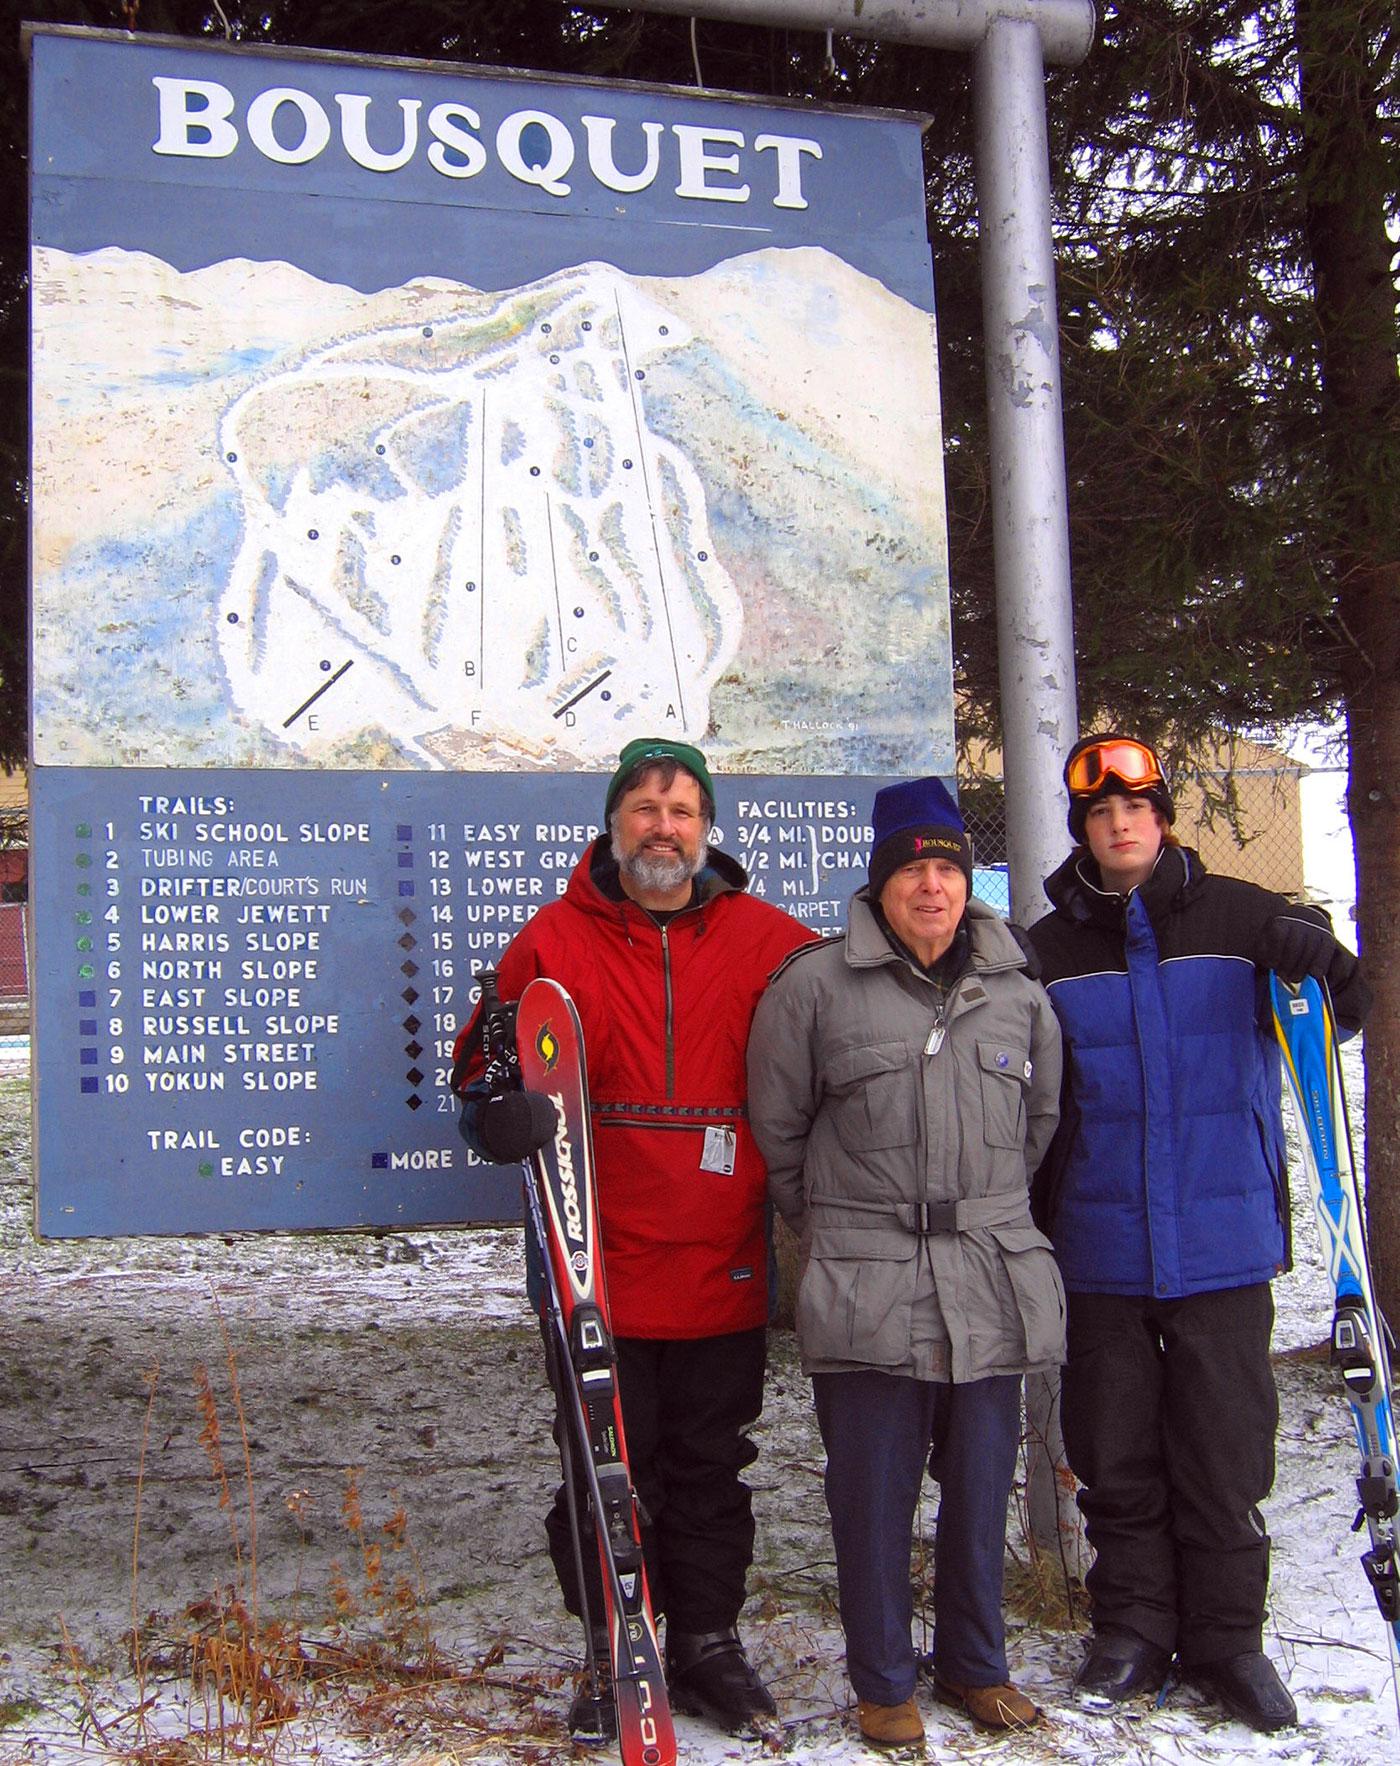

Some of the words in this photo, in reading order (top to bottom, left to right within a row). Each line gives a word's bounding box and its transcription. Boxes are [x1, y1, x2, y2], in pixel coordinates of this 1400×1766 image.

[152, 76, 823, 209] BOUSQUET
[567, 637, 577, 652] C
[464, 661, 476, 676] B
[471, 710, 482, 726] F
[565, 711, 576, 727] D
[665, 703, 676, 719] A
[308, 714, 320, 731] E
[138, 796, 234, 816] TRAILS:
[738, 800, 856, 819] FACILITIES:
[106, 822, 114, 840] 1
[140, 822, 178, 841] SKI
[195, 823, 289, 842] SCHOOL
[299, 823, 370, 842] SLOPE
[427, 823, 446, 841] 11
[464, 824, 521, 842] EASY
[535, 824, 600, 843] RIDER
[737, 823, 772, 849] 3/4
[779, 826, 806, 843] MI.
[821, 825, 875, 844] DOUB
[106, 850, 119, 869] 2
[141, 848, 213, 867] TUBING
[227, 849, 279, 867] AREA
[429, 850, 450, 869] 12
[464, 850, 525, 869] WEST
[739, 850, 769, 873] 1/2
[779, 851, 807, 869] MI.
[107, 878, 120, 897] 3
[331, 878, 367, 896] RUN
[430, 878, 452, 896] 13
[467, 877, 543, 896] LOWER
[744, 873, 767, 897] /4
[782, 879, 810, 896] MI.
[104, 905, 120, 924] 4
[141, 904, 219, 924] LOWER
[237, 905, 331, 924] JEWETT
[431, 905, 454, 923] 14
[467, 904, 539, 923] UPPER
[108, 932, 121, 952] 5
[142, 933, 230, 953] HARRIS
[246, 932, 320, 952] SLOPE
[432, 932, 453, 950] 15
[468, 931, 519, 949] UPP
[107, 961, 121, 979] 6
[143, 960, 222, 980] NORTH
[241, 960, 317, 980] SLOPE
[432, 959, 454, 978] 16
[109, 988, 122, 1008] 7
[143, 988, 206, 1008] EAST
[224, 988, 300, 1007] SLOPE
[432, 986, 454, 1004] 17
[109, 1017, 123, 1036] 8
[143, 1016, 250, 1036] RUSSELL
[265, 1015, 339, 1036] SLOPE
[433, 1013, 456, 1032] 18
[110, 1045, 125, 1064] 9
[143, 1044, 205, 1065] MAIN
[224, 1043, 315, 1063] STREET
[434, 1040, 455, 1058] 19
[105, 1073, 129, 1093] 10
[145, 1072, 224, 1092] YOKUN
[242, 1071, 317, 1091] SLOPE
[437, 1093, 455, 1112] 21
[147, 1130, 220, 1150] TRAIL
[239, 1126, 311, 1148] CODE:
[221, 1156, 284, 1176] EASY
[391, 1149, 453, 1170] MORE
